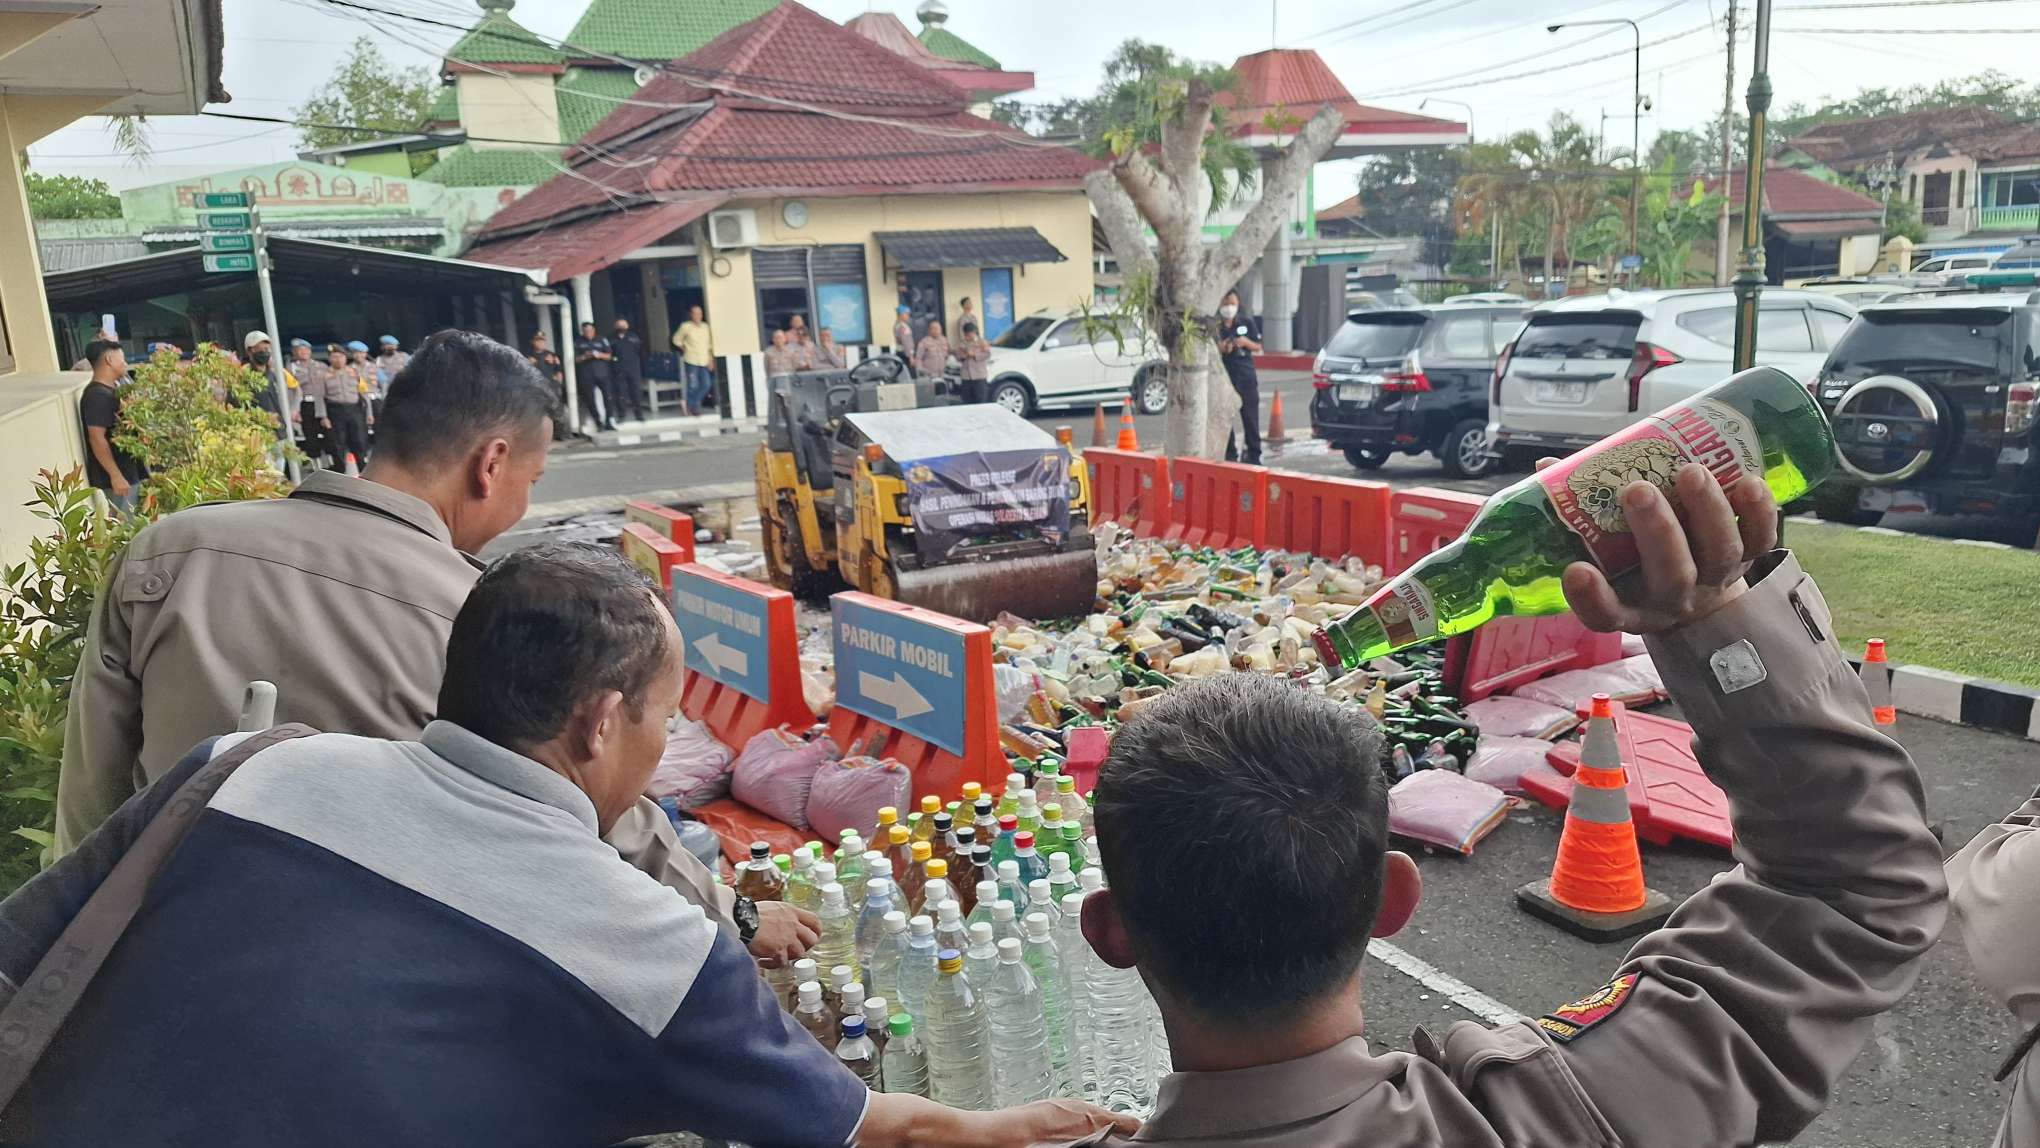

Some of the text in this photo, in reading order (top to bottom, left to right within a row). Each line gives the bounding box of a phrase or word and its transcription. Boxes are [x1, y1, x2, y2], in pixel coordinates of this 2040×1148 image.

[706, 599, 734, 626] MOTOR
[734, 608, 761, 637] UMUM
[1399, 582, 1430, 621] SINGARAJA
[840, 622, 953, 678] PARKIR MOBIL
